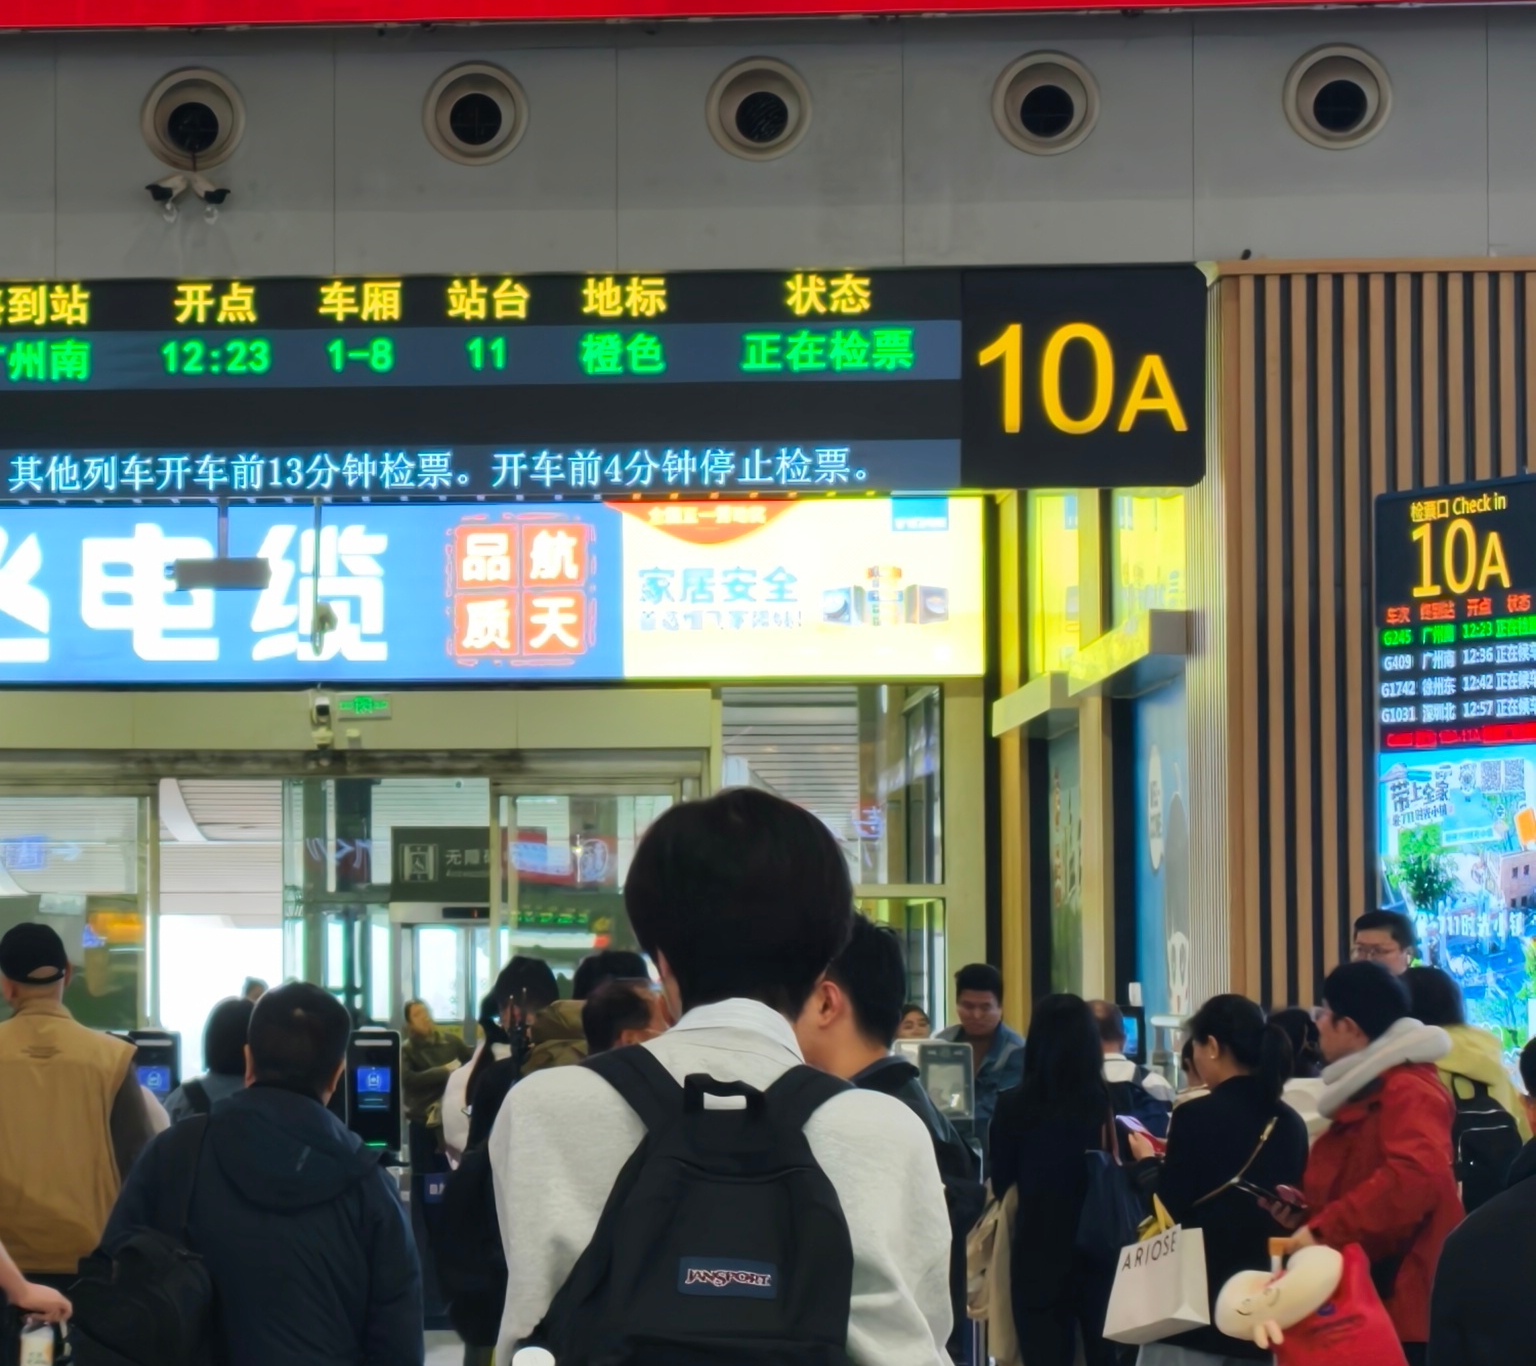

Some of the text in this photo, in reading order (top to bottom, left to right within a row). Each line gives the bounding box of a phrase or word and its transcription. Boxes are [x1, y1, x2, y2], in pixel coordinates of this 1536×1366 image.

[174, 283, 257, 324] 开点
[319, 281, 402, 321] 车厢
[447, 279, 531, 320] 站台
[582, 277, 667, 318] 地标
[785, 274, 872, 316] 状态
[161, 341, 270, 375] 12:23
[328, 339, 394, 372] 1-8
[468, 338, 507, 370] 11
[581, 333, 666, 376] 橙色
[741, 329, 915, 373] 正在检票
[978, 323, 1190, 434] 10A
[1410, 491, 1507, 523] 检票口 Check in
[1412, 518, 1512, 598] 10A
[637, 566, 799, 605] 家居安全
[1462, 620, 1493, 639] 12:23
[1383, 654, 1413, 672] G409
[1421, 648, 1457, 671] 广州南
[1463, 645, 1493, 666] 12:36
[1381, 680, 1416, 699] G1742
[1463, 673, 1493, 692] 12:42
[1381, 705, 1416, 724] G1031
[1463, 699, 1493, 718] 12:57
[1122, 1230, 1177, 1272] ARIOSE
[684, 1268, 772, 1287] JANSPORT
